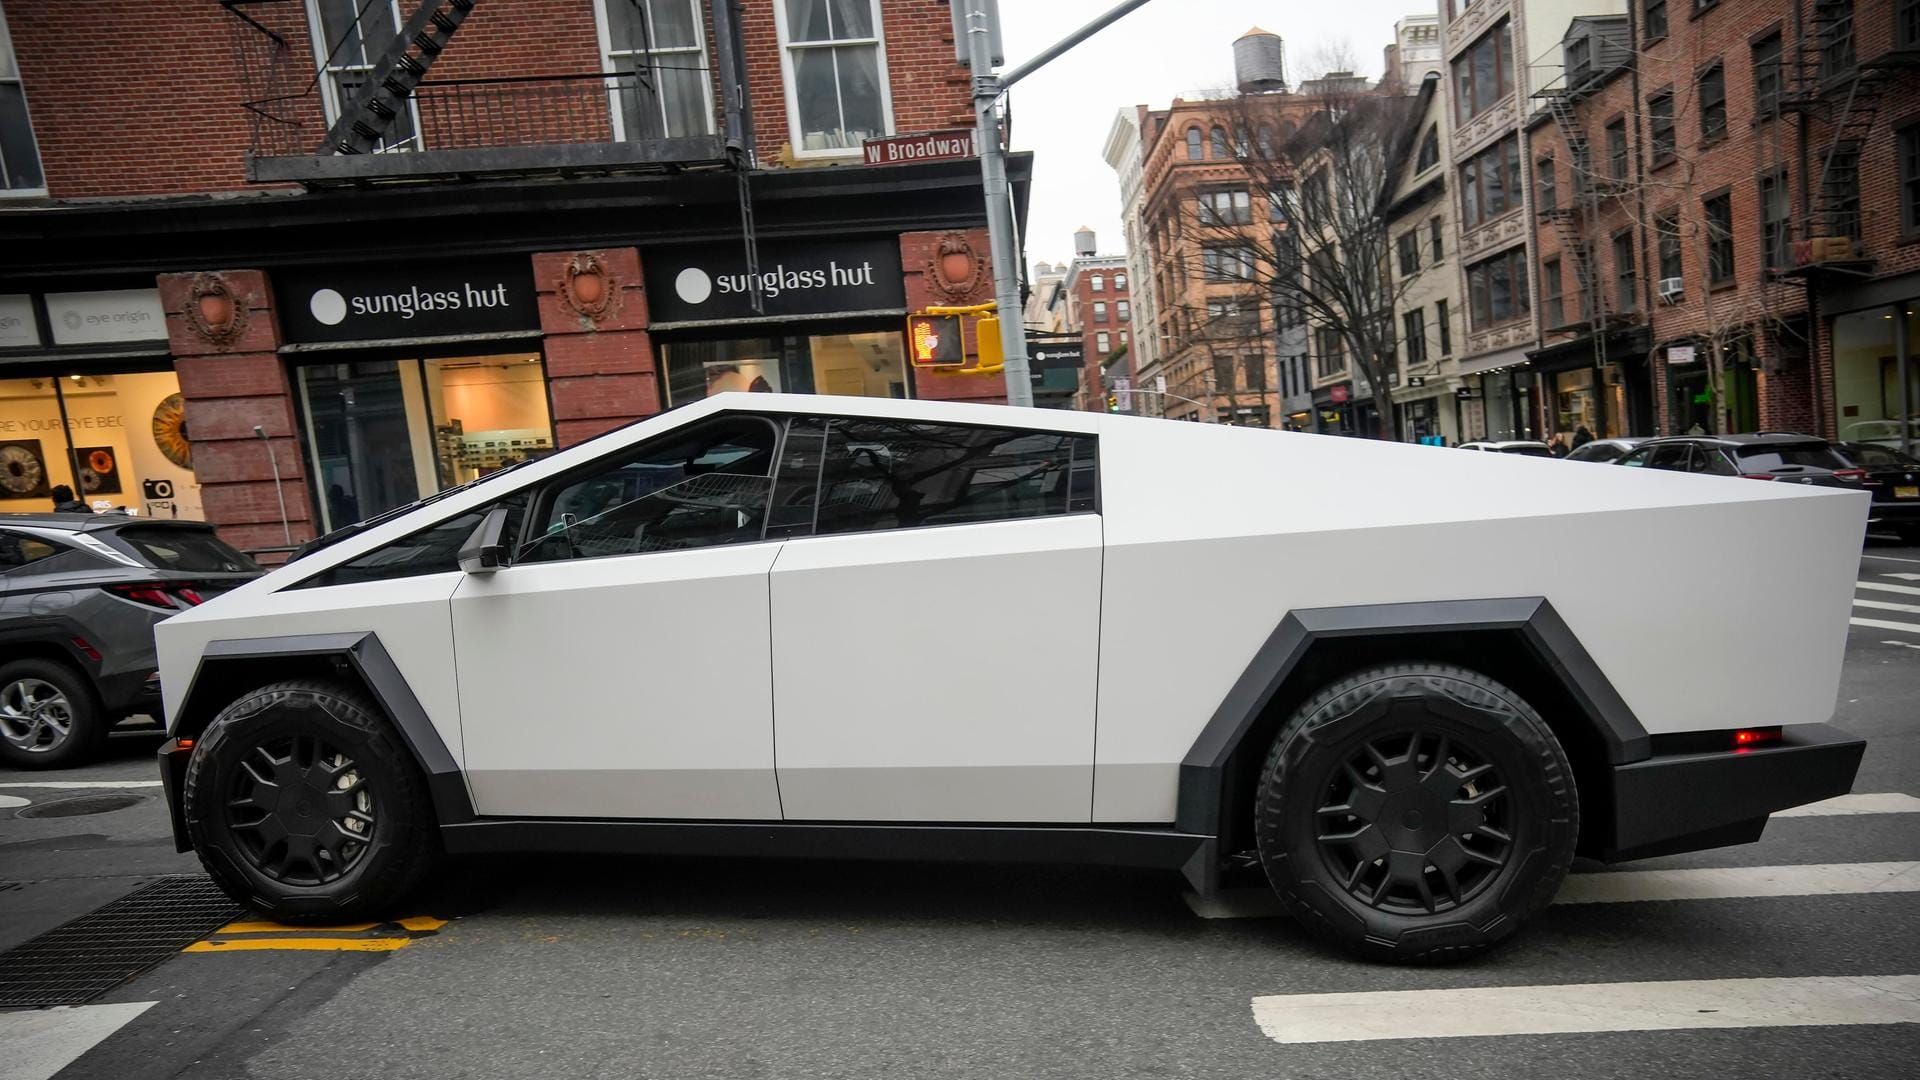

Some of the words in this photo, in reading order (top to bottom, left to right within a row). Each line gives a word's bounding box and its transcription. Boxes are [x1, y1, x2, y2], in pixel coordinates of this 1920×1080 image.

[867, 144, 881, 163] W
[887, 137, 969, 158] Broadway
[717, 264, 827, 298] sunglass
[830, 261, 875, 286] hut
[351, 285, 462, 319] sunglass
[464, 282, 510, 307] hut
[86, 313, 110, 326] eye
[114, 310, 151, 324] origin
[19, 418, 62, 432] YOUR
